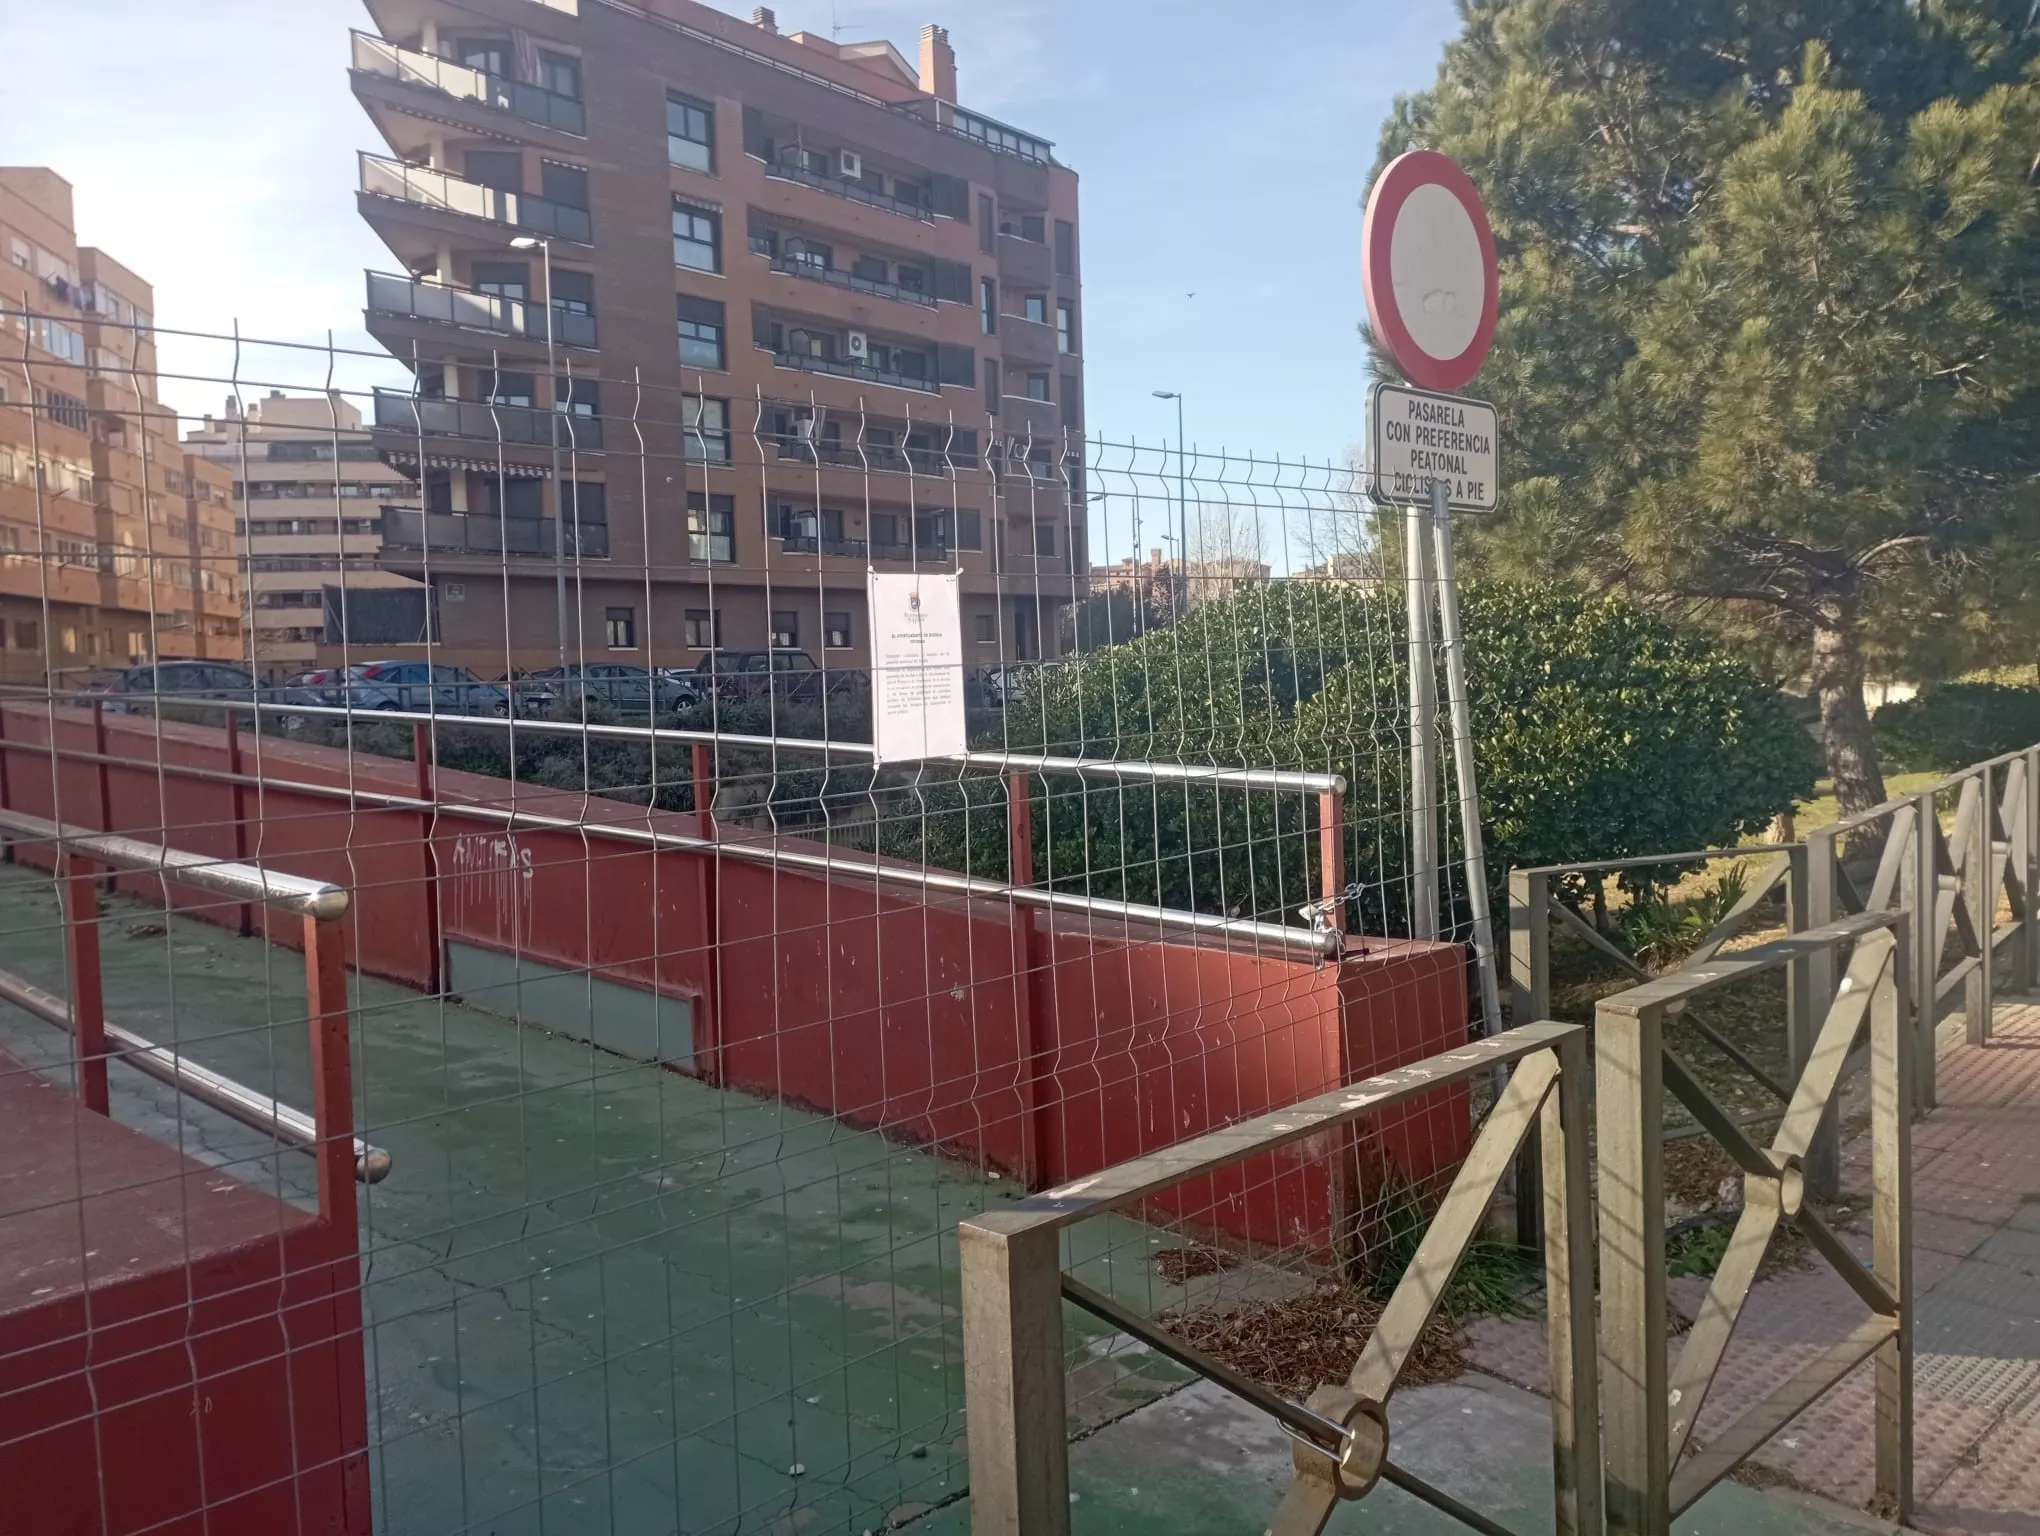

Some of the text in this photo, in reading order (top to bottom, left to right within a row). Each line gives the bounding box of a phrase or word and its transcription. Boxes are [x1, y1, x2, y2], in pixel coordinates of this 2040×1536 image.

[1408, 400, 1465, 428] PASARELA
[1386, 420, 1490, 455] CON PREFERENCIA
[1411, 449, 1468, 475] PEATONAL
[1394, 472, 1485, 501] CICLISS A PIE
